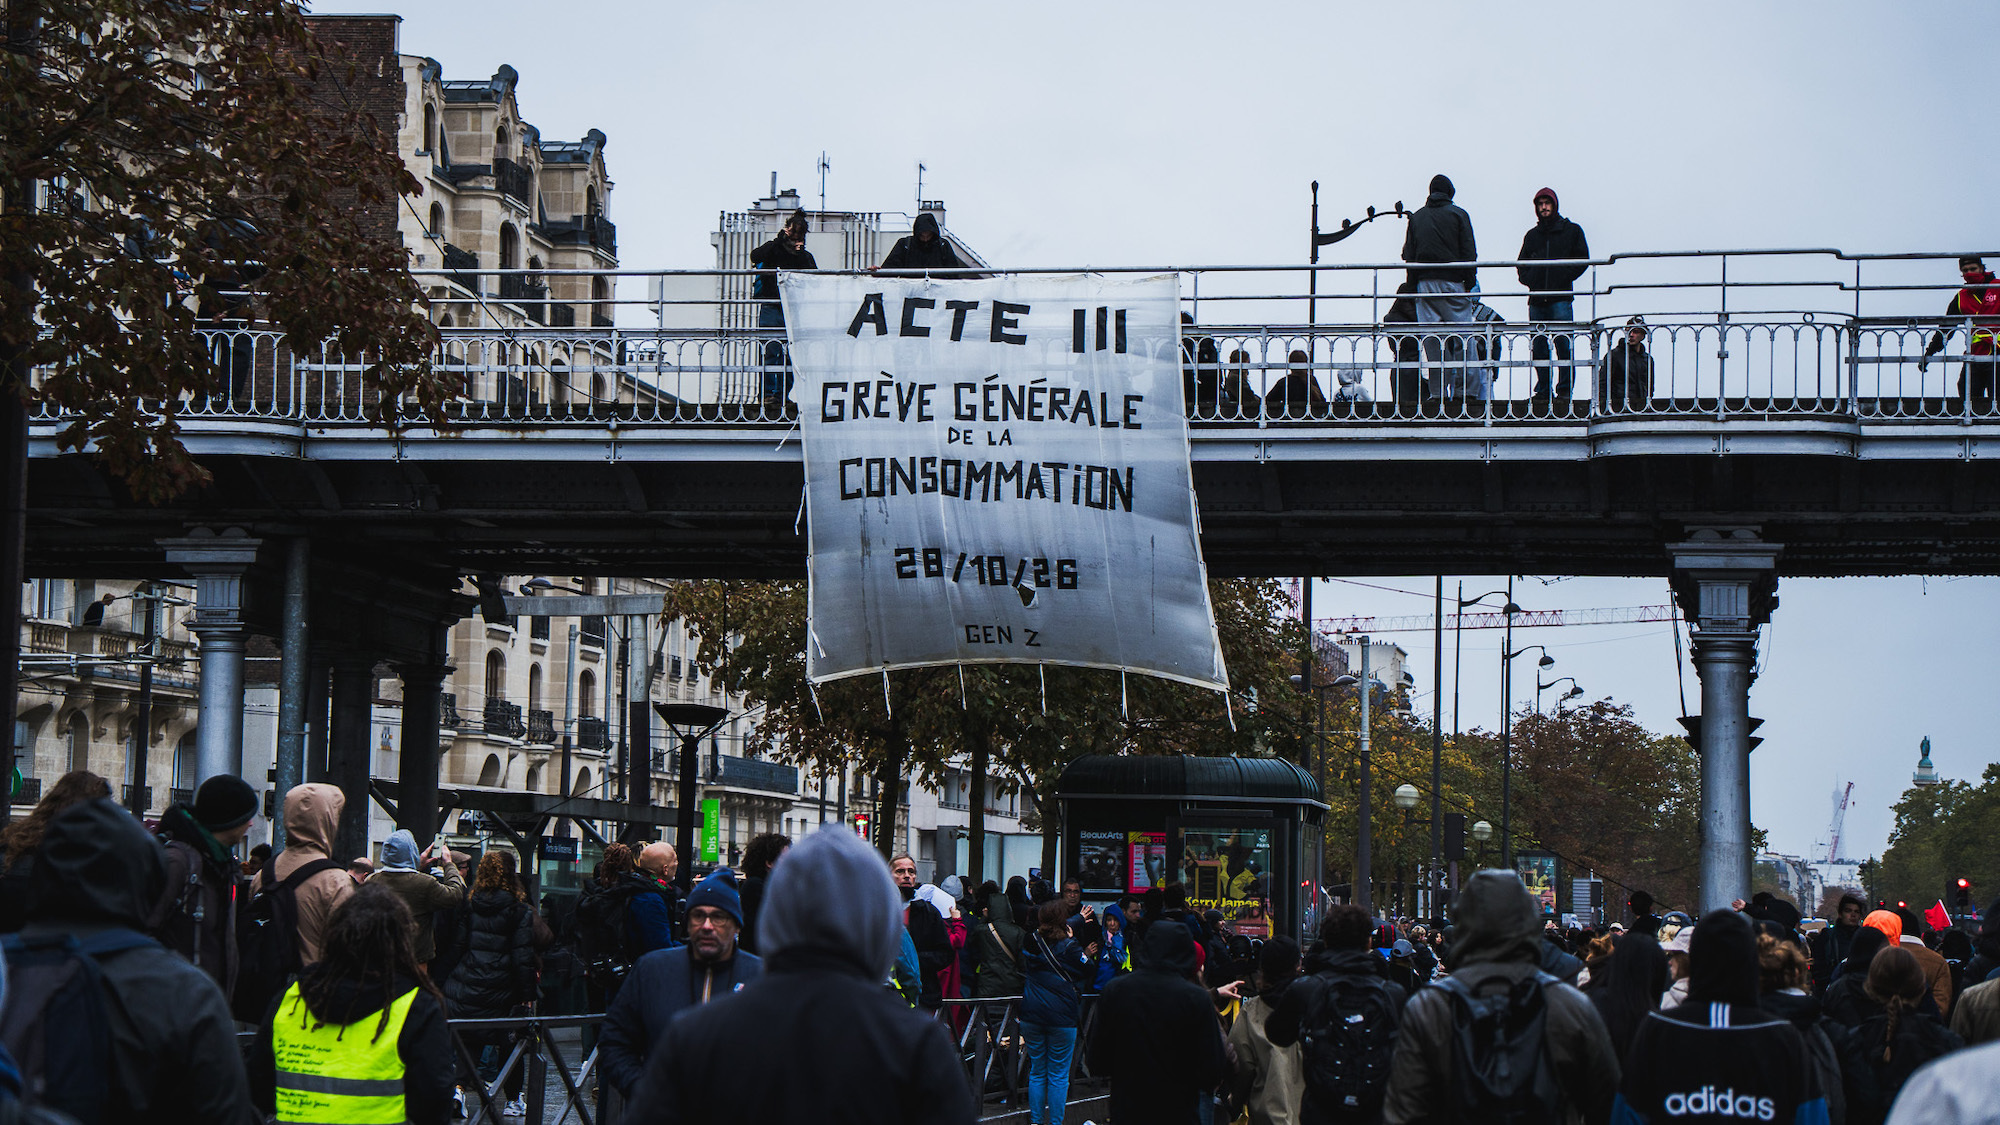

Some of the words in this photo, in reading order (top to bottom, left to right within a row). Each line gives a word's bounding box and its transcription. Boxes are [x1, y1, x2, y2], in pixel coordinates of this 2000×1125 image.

[847, 292, 1030, 346] ACTE
[1072, 306, 1127, 353] III
[821, 371, 937, 423] GRÈVE
[954, 374, 1143, 430] GÉNÉRALE
[947, 427, 973, 445] DE
[987, 428, 1013, 447] LA
[894, 547, 1079, 590] 28/10/26
[965, 624, 1012, 644] GEN
[1023, 628, 1041, 647] Z
[706, 835, 717, 853] ibis
[1080, 830, 1124, 840] BeauxArts
[1185, 896, 1218, 909] Kerry
[1221, 897, 1260, 908] James
[1665, 1085, 1775, 1120] adidas
